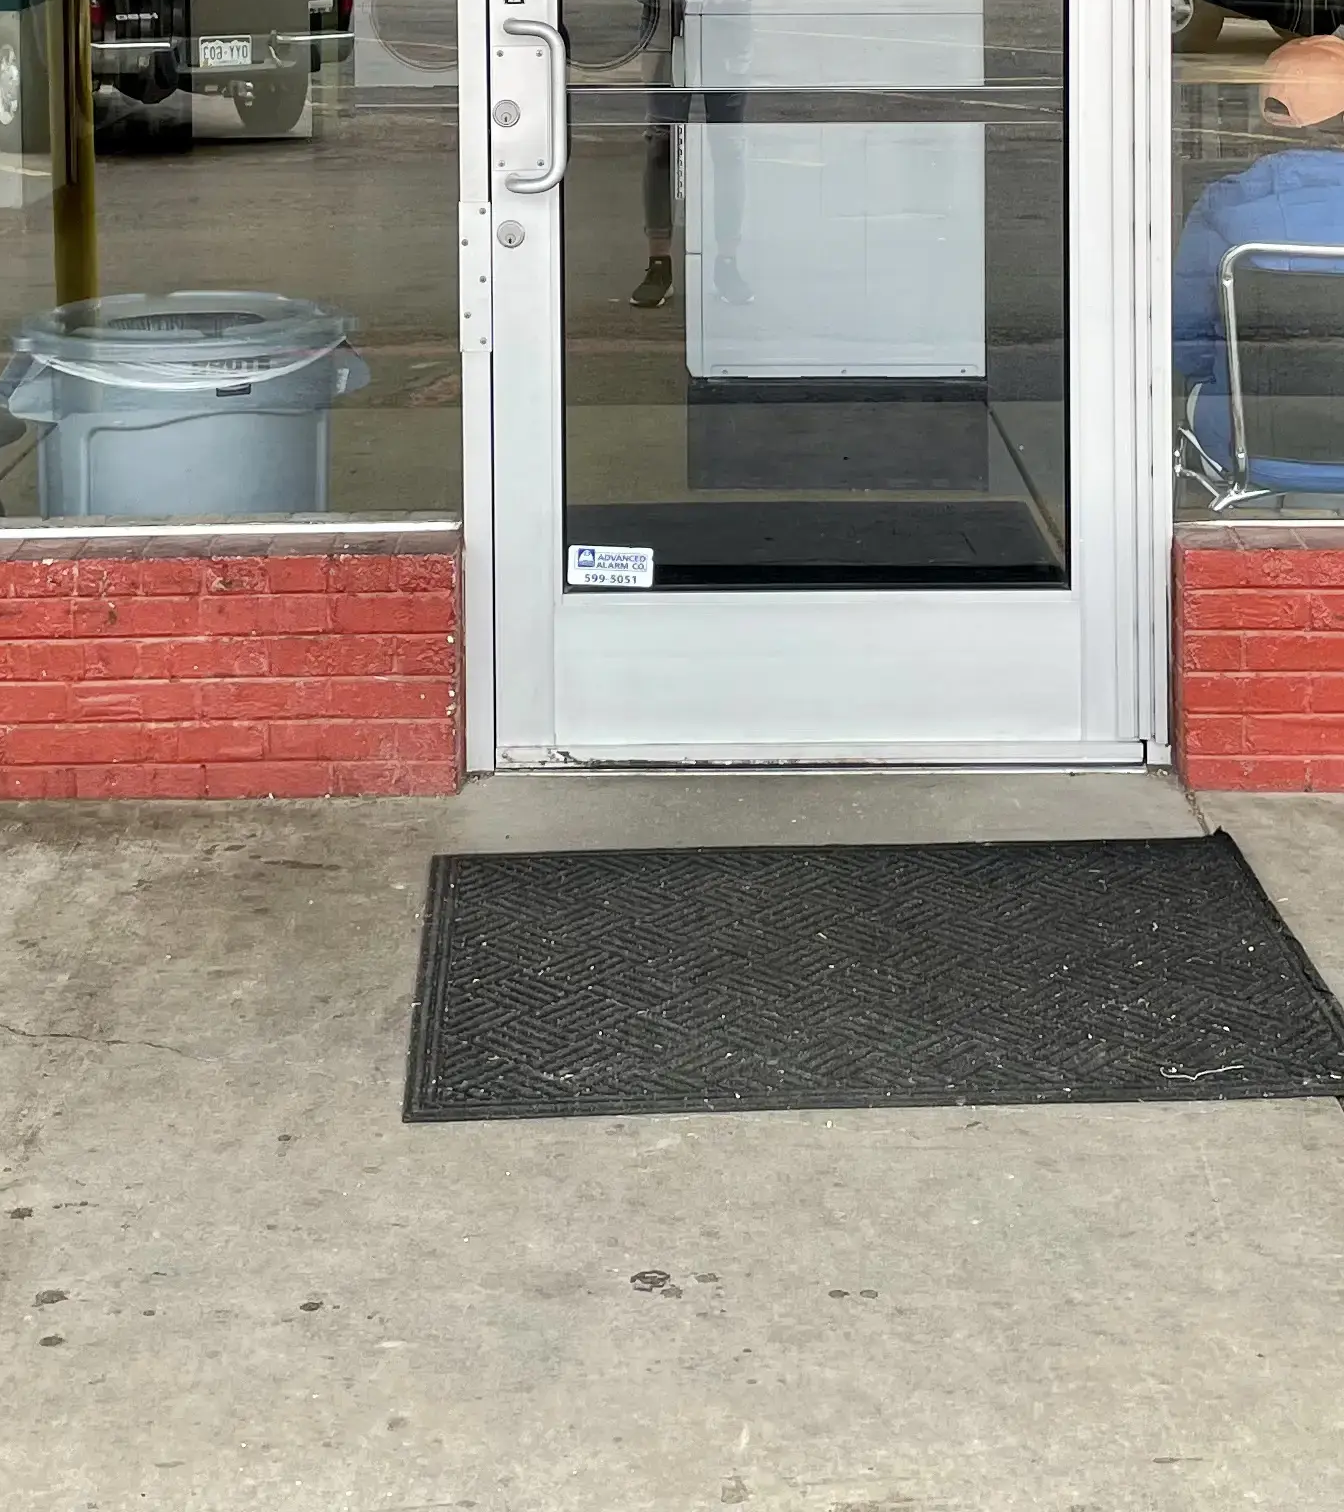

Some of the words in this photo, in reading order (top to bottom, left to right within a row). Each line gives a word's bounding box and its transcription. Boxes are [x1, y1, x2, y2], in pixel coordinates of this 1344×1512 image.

[597, 553, 647, 563] ADVANCED
[596, 562, 629, 570] ALARM
[584, 574, 637, 584] 599-5051
